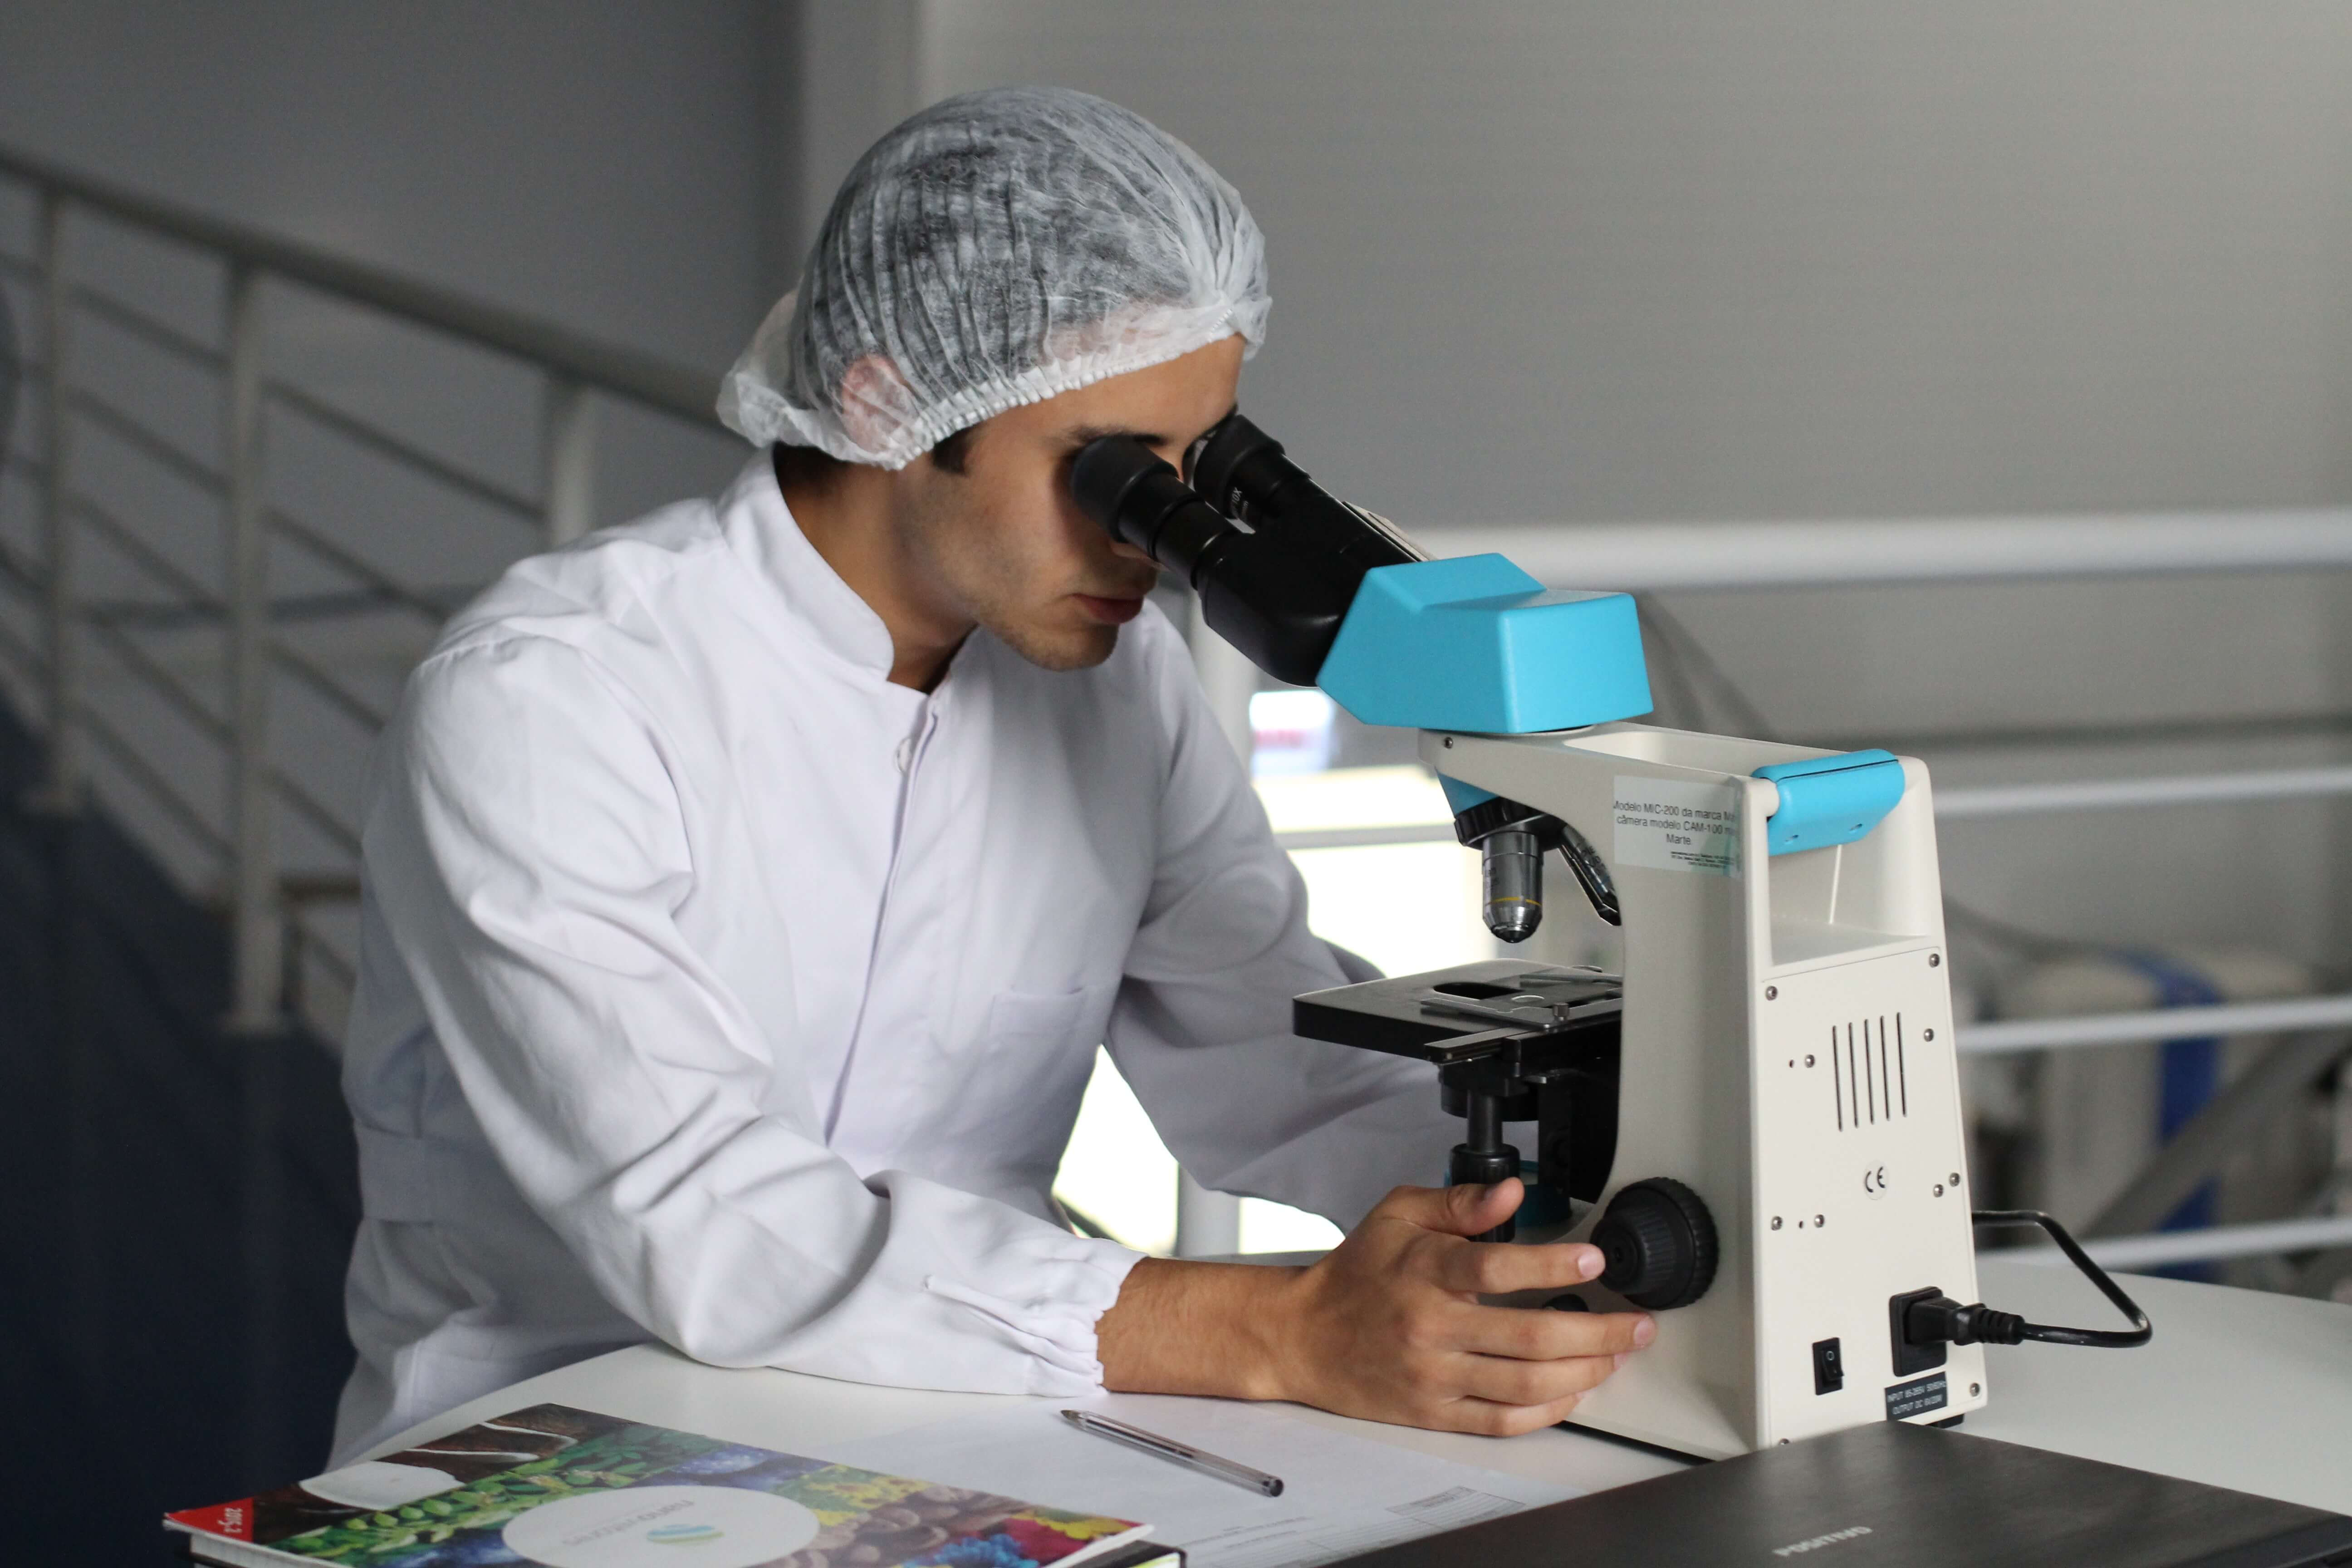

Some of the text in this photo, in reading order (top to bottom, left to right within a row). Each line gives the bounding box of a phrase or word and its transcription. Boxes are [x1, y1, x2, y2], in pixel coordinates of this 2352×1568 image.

[1644, 803, 1679, 816] MIC-200
[1682, 808, 1692, 817] da
[1695, 810, 1722, 820] marca
[1650, 818, 1681, 830] modelo
[1684, 821, 1723, 834] CAM-100
[1666, 833, 1691, 845] Marte
